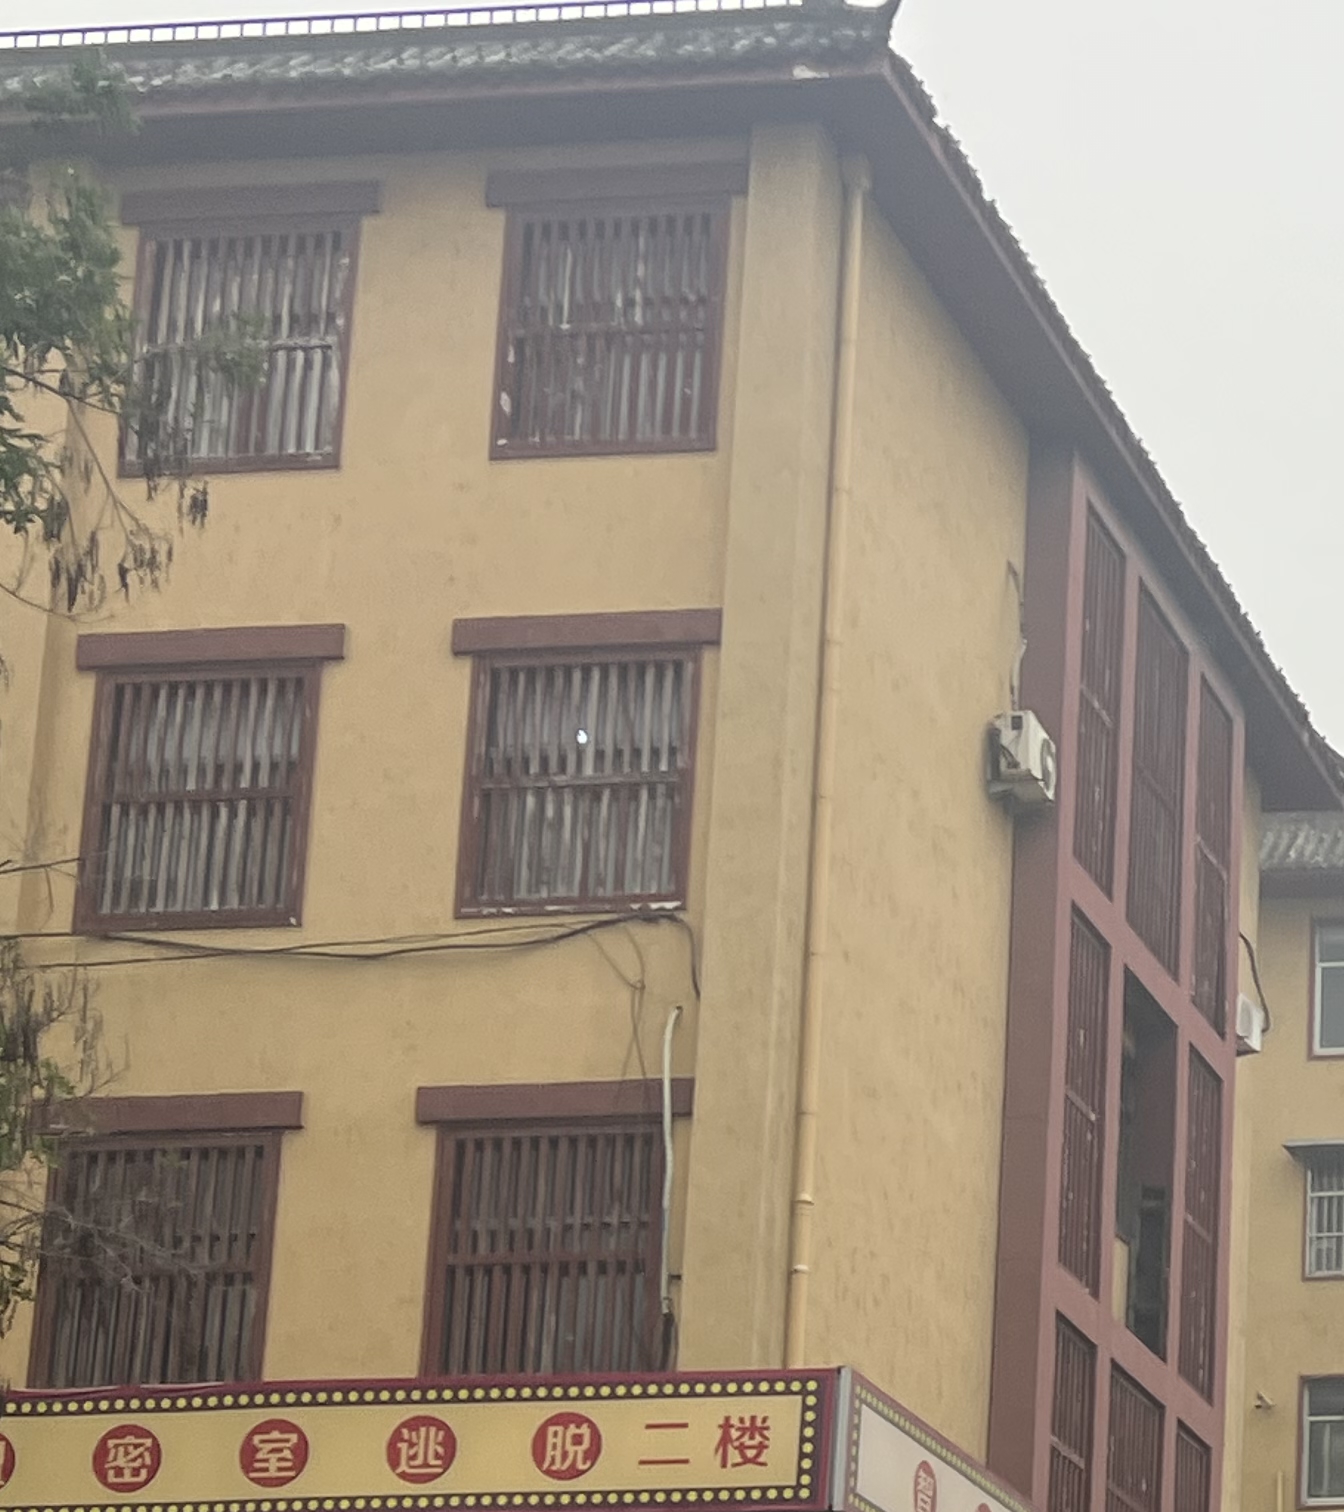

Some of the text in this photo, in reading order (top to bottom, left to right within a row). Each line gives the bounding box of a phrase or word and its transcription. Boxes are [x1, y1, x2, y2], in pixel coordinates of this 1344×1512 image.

[0, 1414, 771, 1486] 密室逃脱二楼
